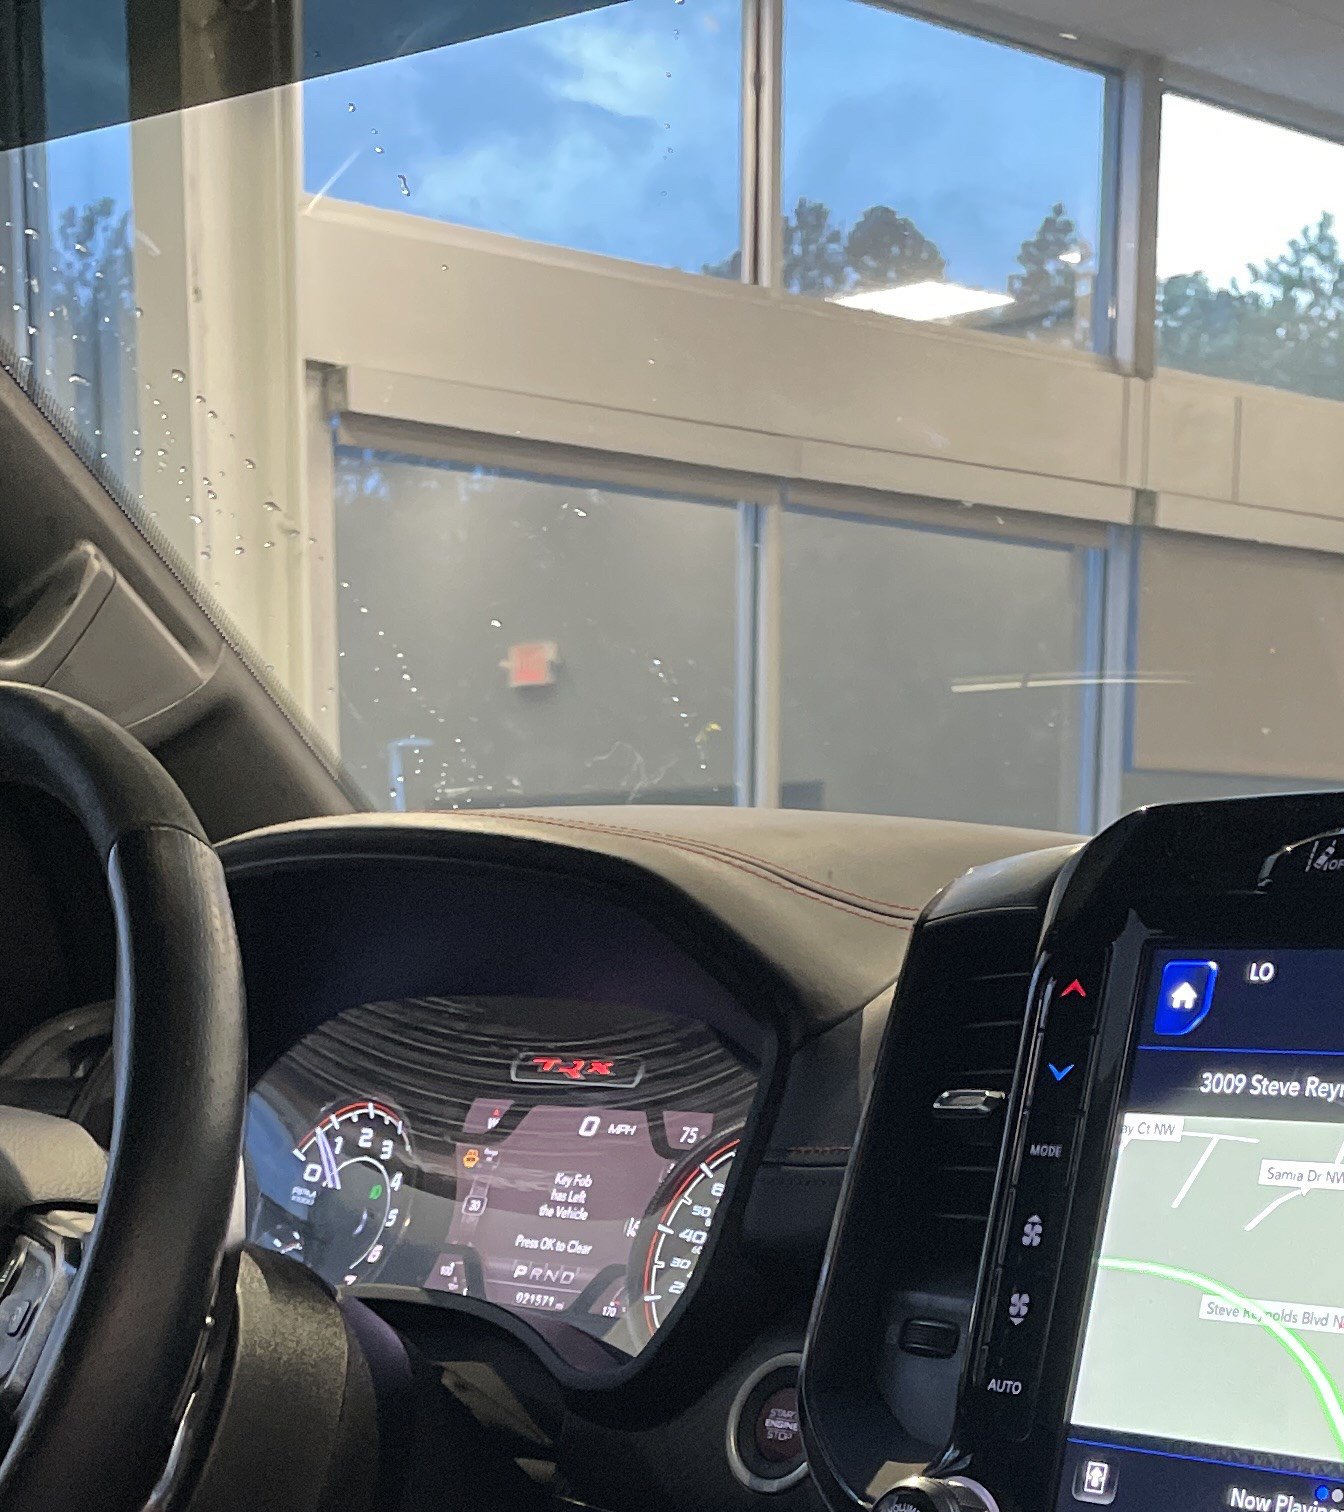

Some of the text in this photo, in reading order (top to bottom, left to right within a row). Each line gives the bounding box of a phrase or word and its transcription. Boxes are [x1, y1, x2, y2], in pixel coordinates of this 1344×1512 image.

[1249, 962, 1275, 981] LO
[532, 1056, 616, 1081] TRX
[1199, 1072, 1247, 1094] 3009
[1249, 1074, 1301, 1097] Steve
[578, 1115, 637, 1138] 0 MPH
[1137, 1121, 1150, 1135] Ct
[1154, 1122, 1176, 1136] NW
[333, 1136, 344, 1154] 1
[358, 1127, 374, 1148] 2
[379, 1140, 394, 1159] 3
[1030, 1143, 1063, 1158] MODE
[302, 1163, 323, 1183] 0
[390, 1171, 404, 1191] 4
[554, 1172, 593, 1188] Key Fob
[1307, 1169, 1324, 1185] Dr
[550, 1188, 587, 1204] has Left
[384, 1208, 399, 1228] 5
[538, 1203, 589, 1221] the Vehicle
[691, 1204, 712, 1218] 50
[515, 1234, 593, 1255] Press OK Clear
[678, 1228, 708, 1245] 40
[366, 1244, 384, 1264] 6
[669, 1256, 692, 1270] 30
[513, 1264, 576, 1285] P R N D
[1206, 1301, 1239, 1318] Steve
[1301, 1311, 1330, 1327] Blvd
[987, 1378, 1023, 1396] AUTO
[1229, 1487, 1272, 1512] Now
